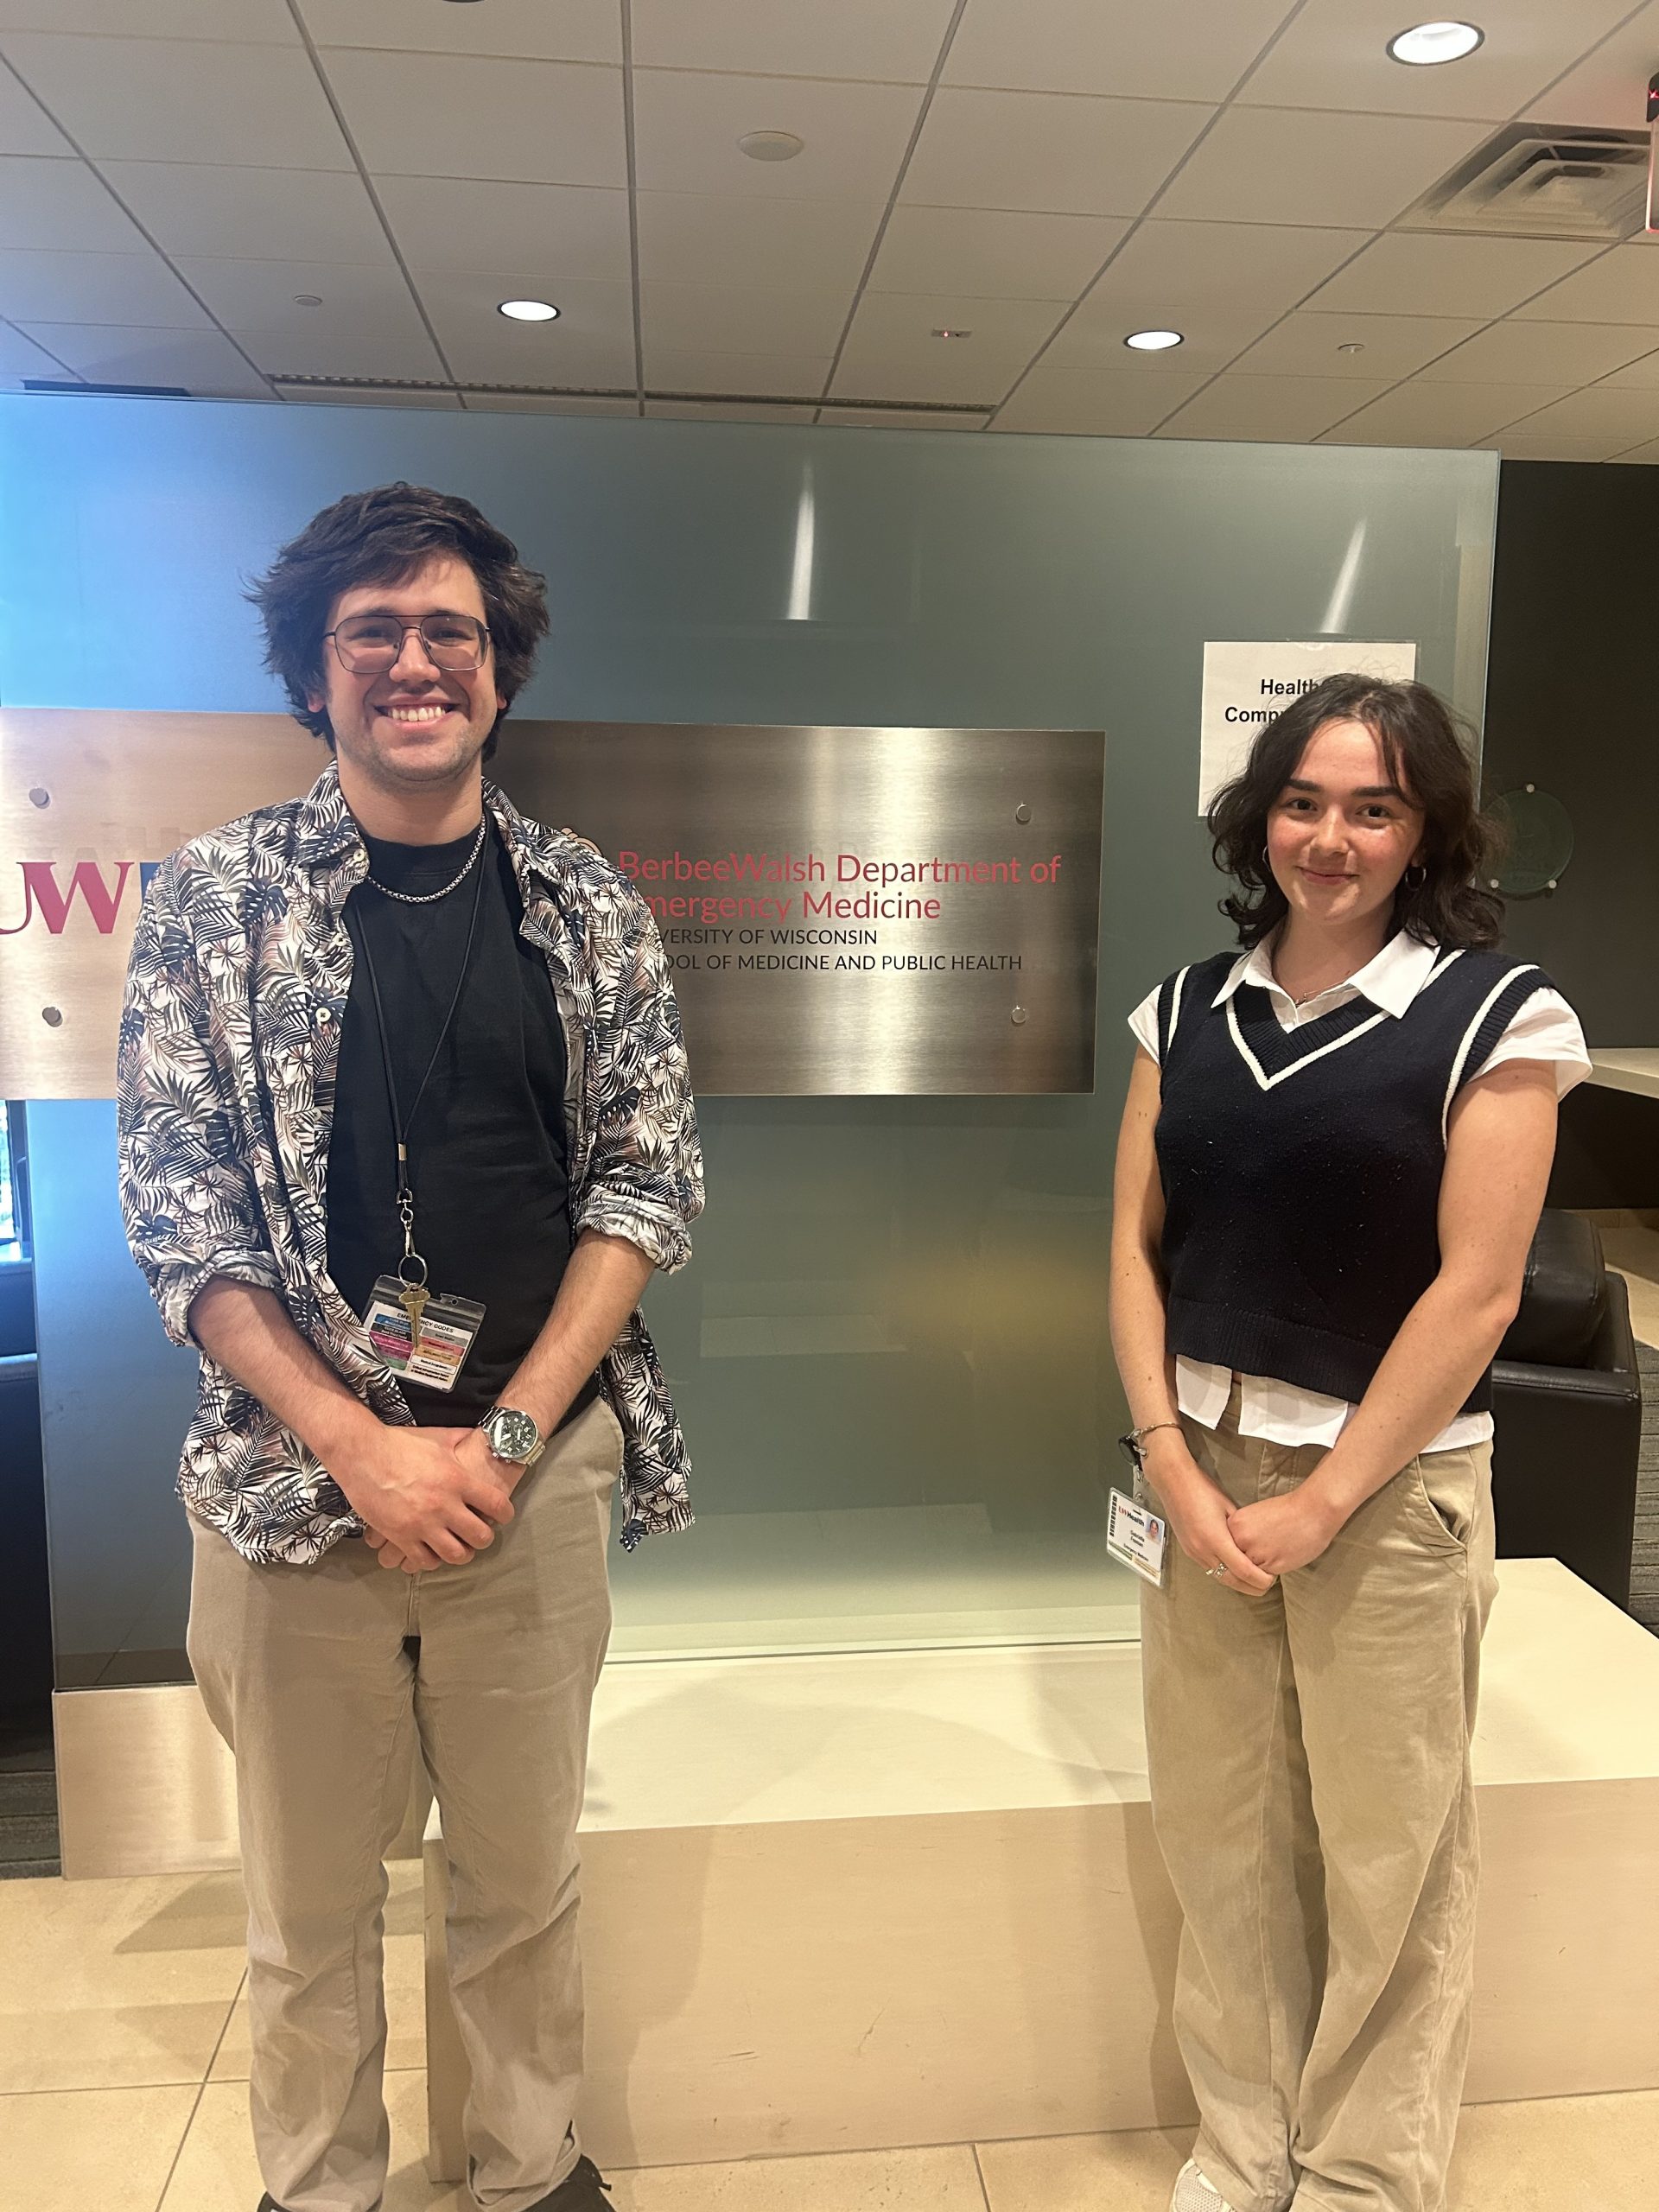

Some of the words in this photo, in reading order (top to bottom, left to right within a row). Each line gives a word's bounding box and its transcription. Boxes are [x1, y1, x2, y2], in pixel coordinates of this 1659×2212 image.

[1225, 706, 1286, 725] Comp
[620, 850, 825, 883] BerbeeWalsh
[837, 854, 1021, 887] Department
[1030, 855, 1062, 883] of
[644, 895, 792, 924] mergency
[803, 891, 941, 919] Medicine
[661, 929, 734, 944] VERSITY
[739, 929, 765, 944] OF
[770, 929, 877, 944] WISCONSIN
[707, 954, 732, 969] OF
[738, 955, 830, 970] MEDICINE
[834, 955, 876, 970] AND
[882, 956, 946, 970] PUBLIC
[951, 956, 1022, 970] HEALTH
